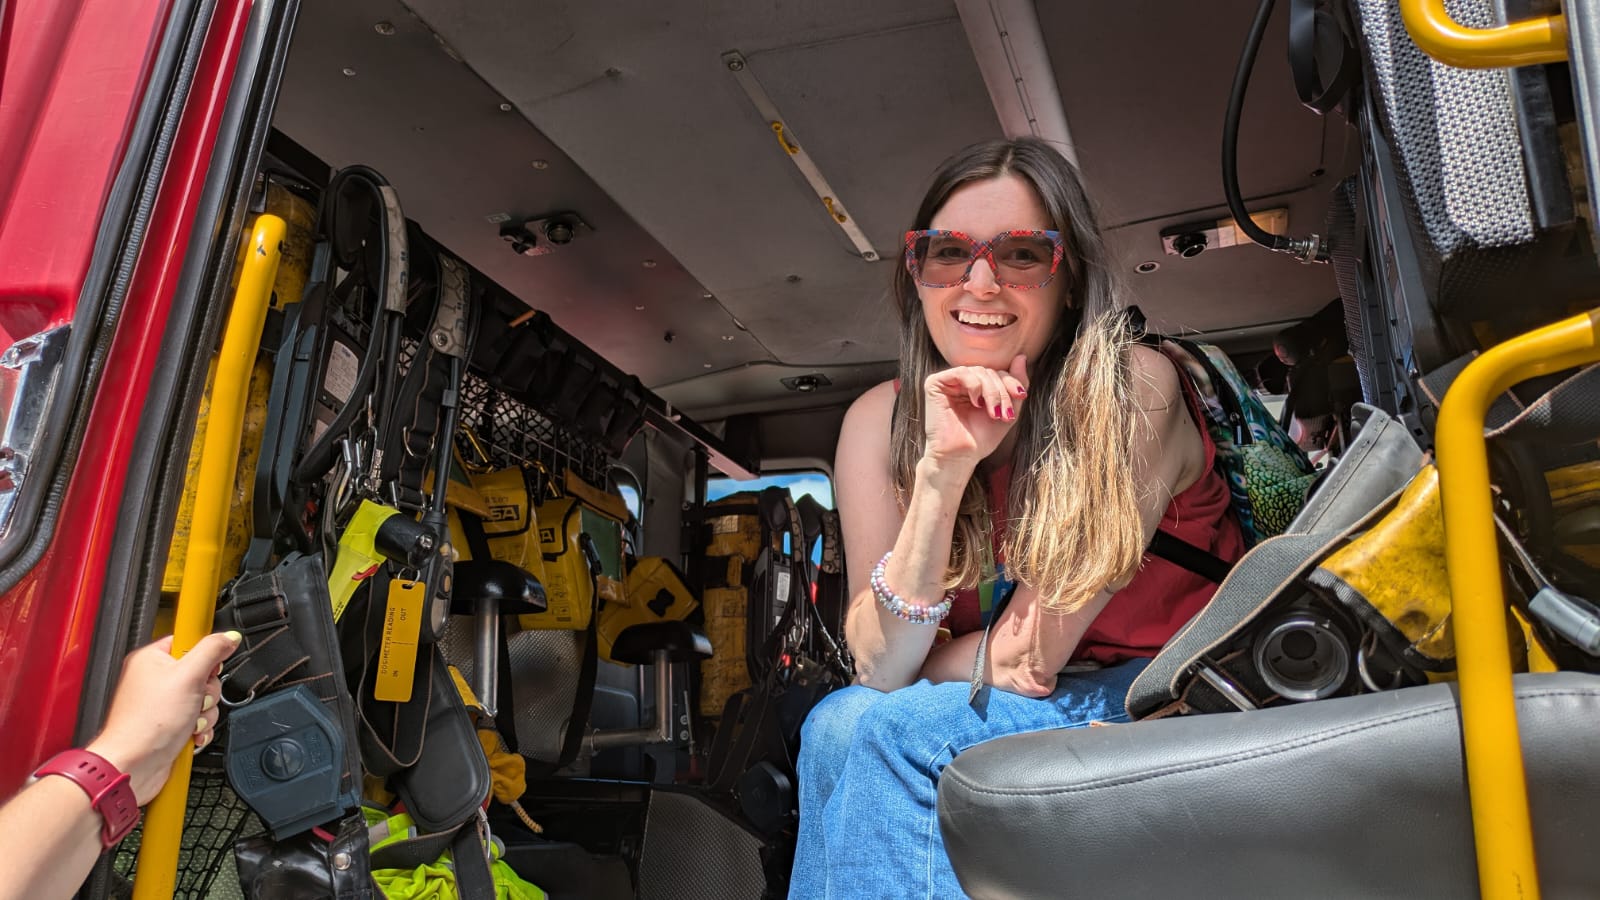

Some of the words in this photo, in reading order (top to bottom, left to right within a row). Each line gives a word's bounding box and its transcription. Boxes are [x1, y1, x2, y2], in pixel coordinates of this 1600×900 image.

[483, 507, 517, 521] SA
[386, 607, 396, 636] READING
[392, 670, 399, 678] IN
